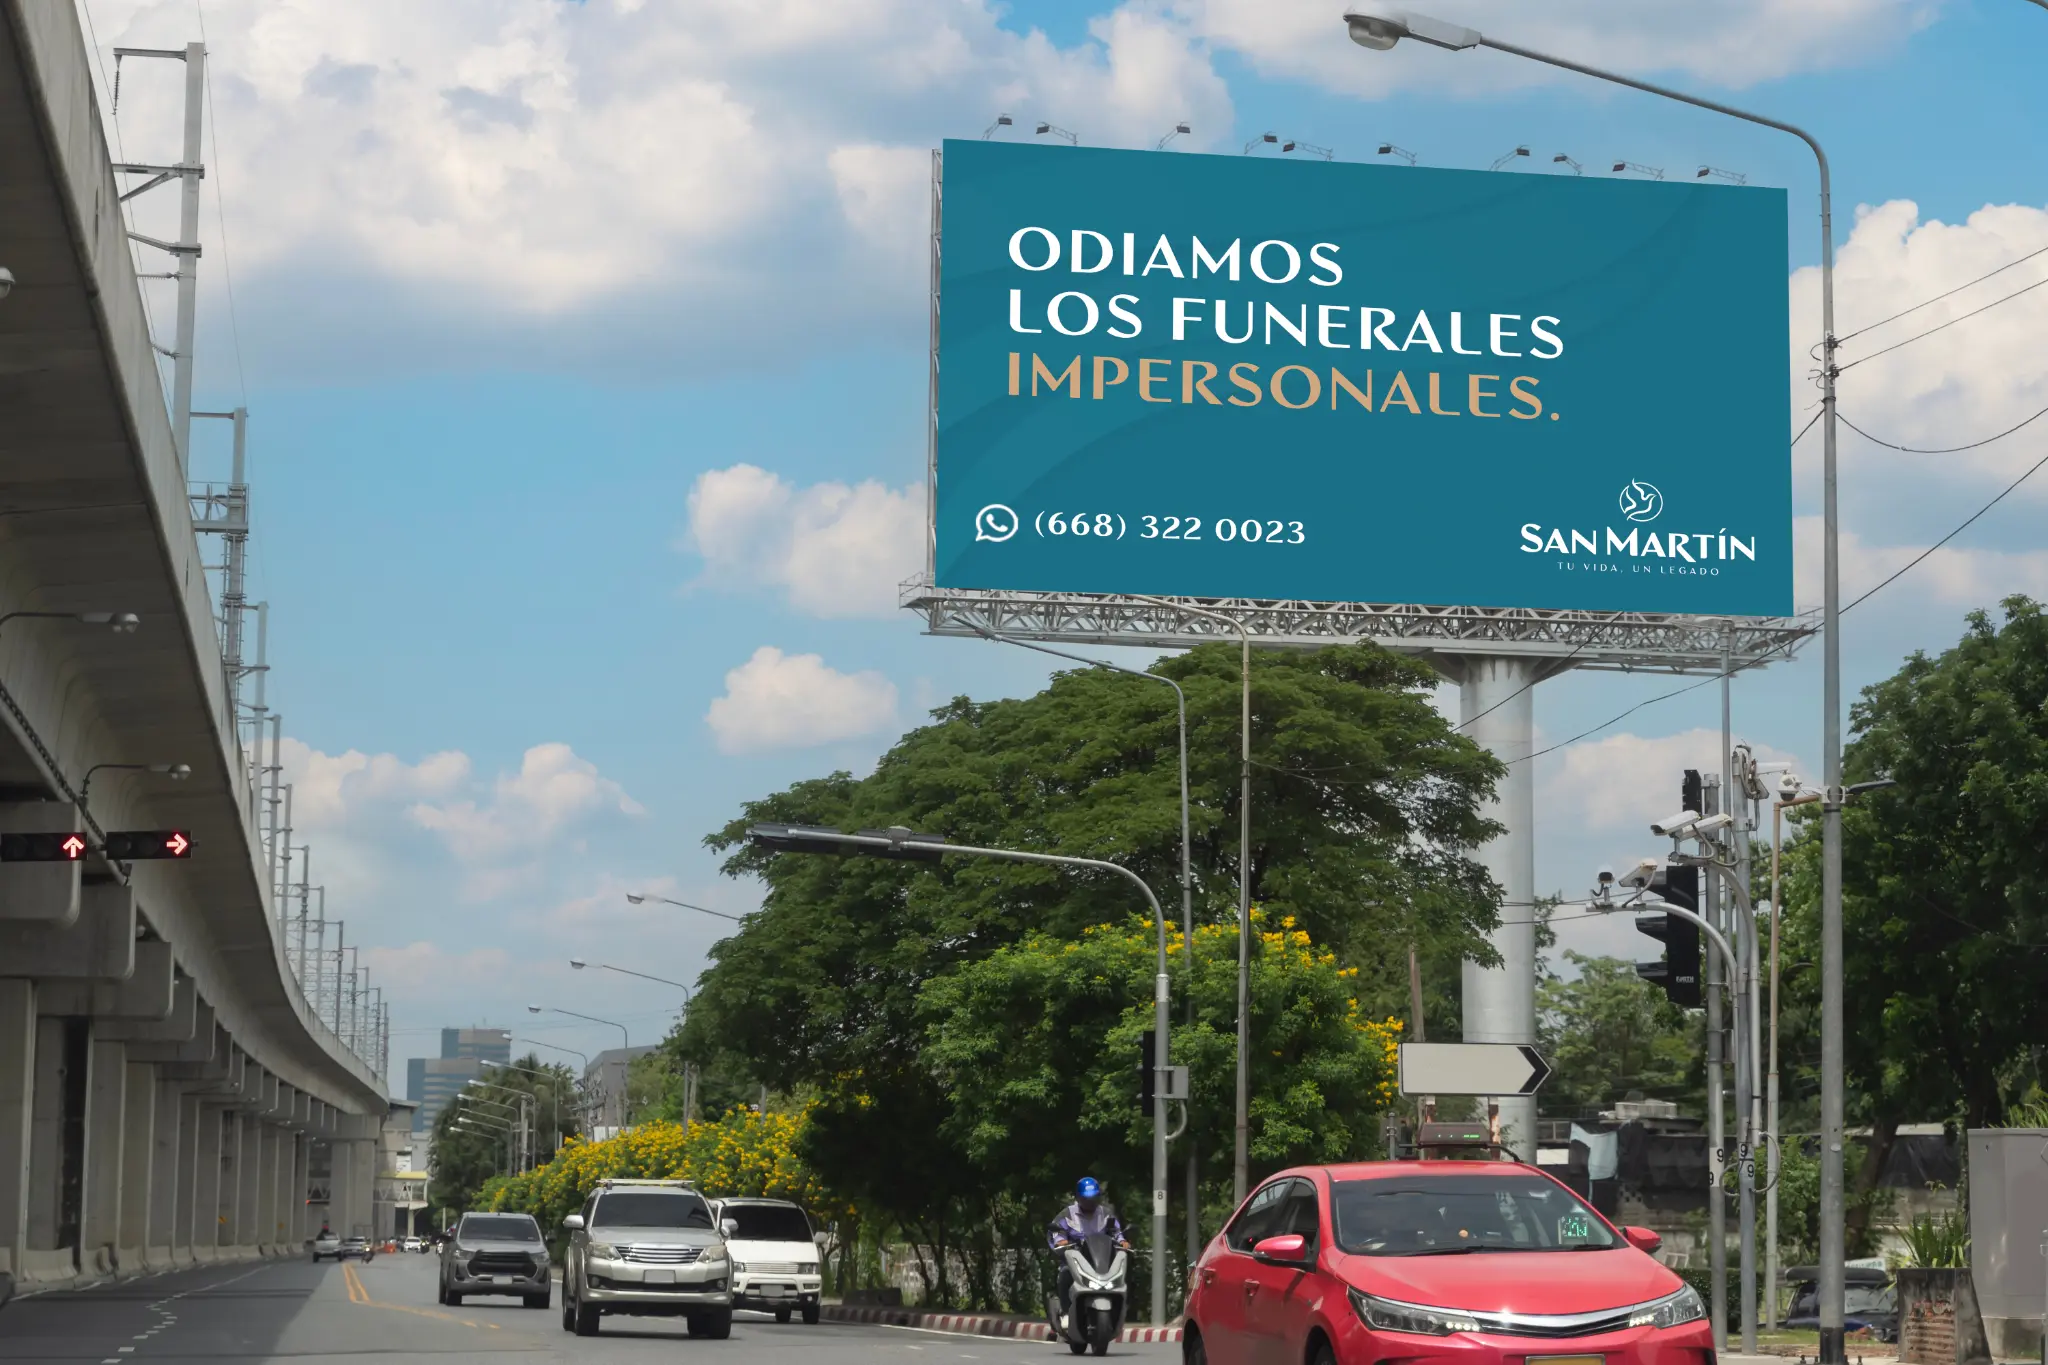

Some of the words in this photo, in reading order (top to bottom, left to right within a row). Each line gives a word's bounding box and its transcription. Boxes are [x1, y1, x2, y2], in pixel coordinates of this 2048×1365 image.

[1008, 226, 1344, 288] ODIAMOS
[1008, 288, 1143, 339] LOS
[1172, 297, 1564, 361] FUNERALES
[1008, 351, 1560, 422] IMPERSONALES.
[1034, 510, 1127, 541] (668)
[1140, 514, 1202, 541] 322
[1215, 518, 1306, 545] 0023
[1557, 562, 1575, 571] TU
[1583, 563, 1624, 574] VIDA,
[1632, 565, 1651, 573] UN
[1660, 566, 1719, 576] LEGADO
